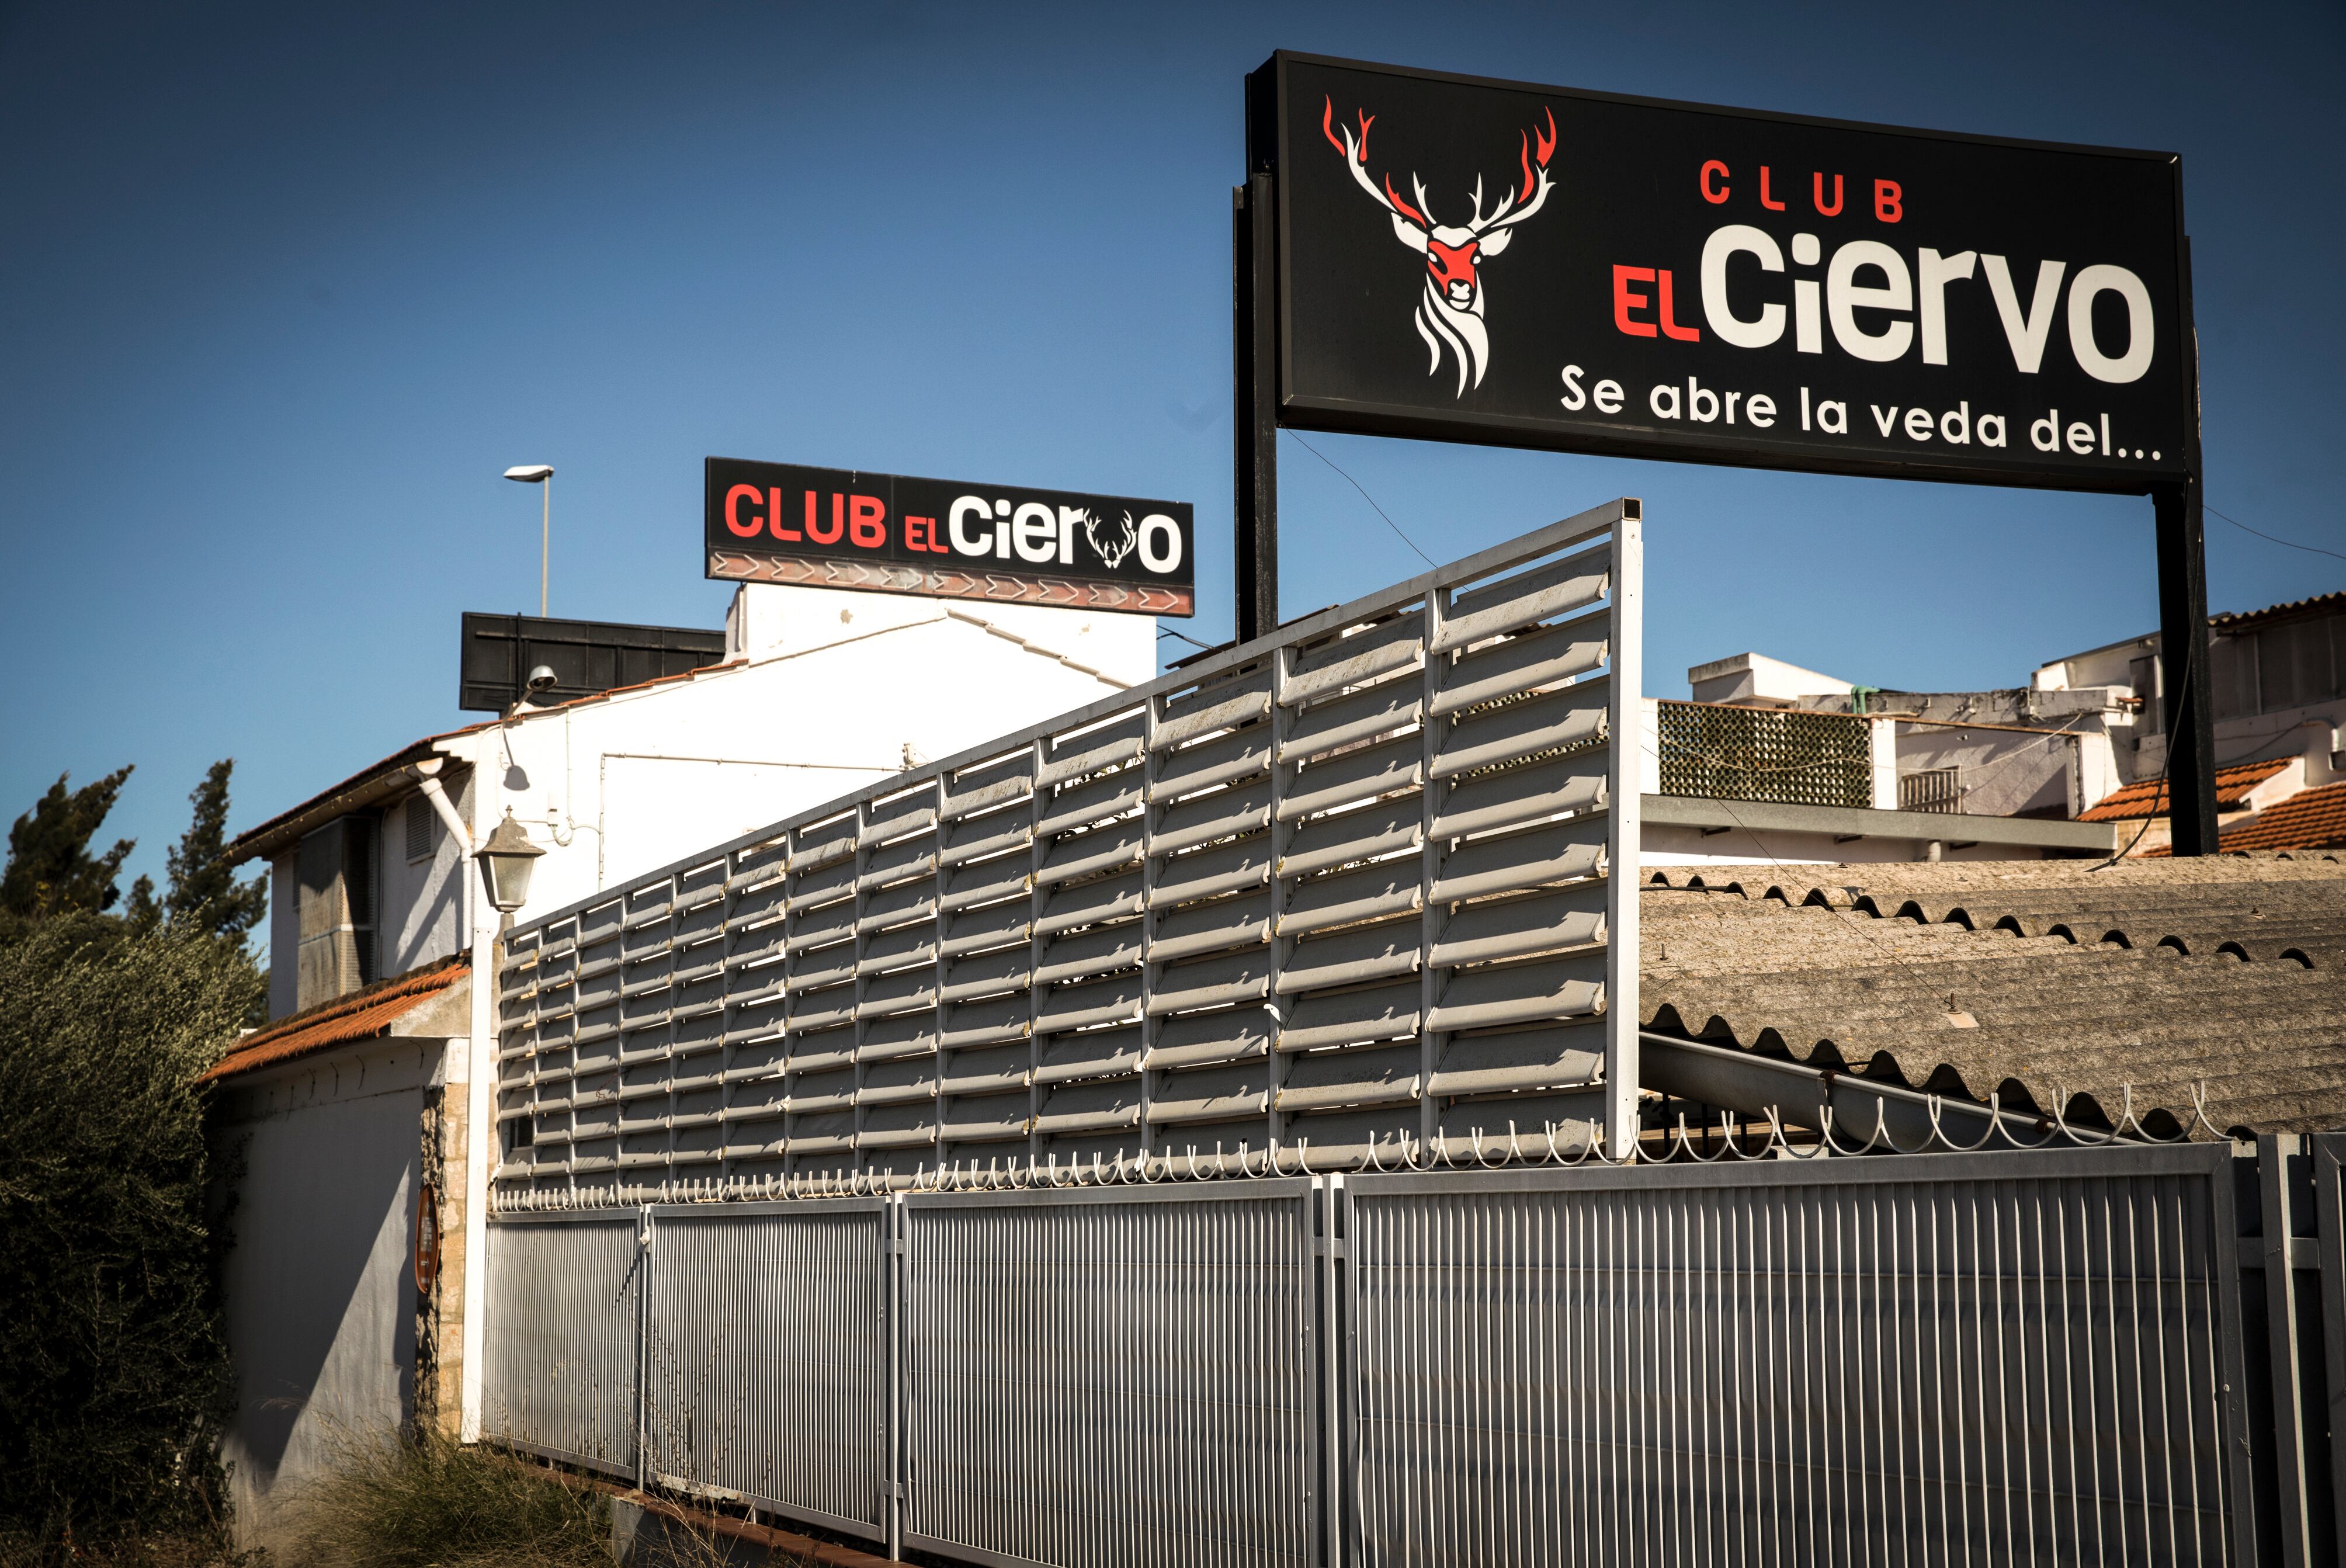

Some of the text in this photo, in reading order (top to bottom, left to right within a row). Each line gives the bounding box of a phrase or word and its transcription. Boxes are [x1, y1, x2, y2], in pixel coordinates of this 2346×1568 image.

[1699, 159, 1903, 224] CLUB
[1612, 224, 2155, 384] EL Ciervo
[1560, 364, 1625, 415] Se
[1649, 375, 1778, 428] abre
[1800, 386, 1848, 435] la
[1869, 400, 2007, 448] veda
[724, 483, 887, 549] CLUB
[904, 515, 949, 554] EL
